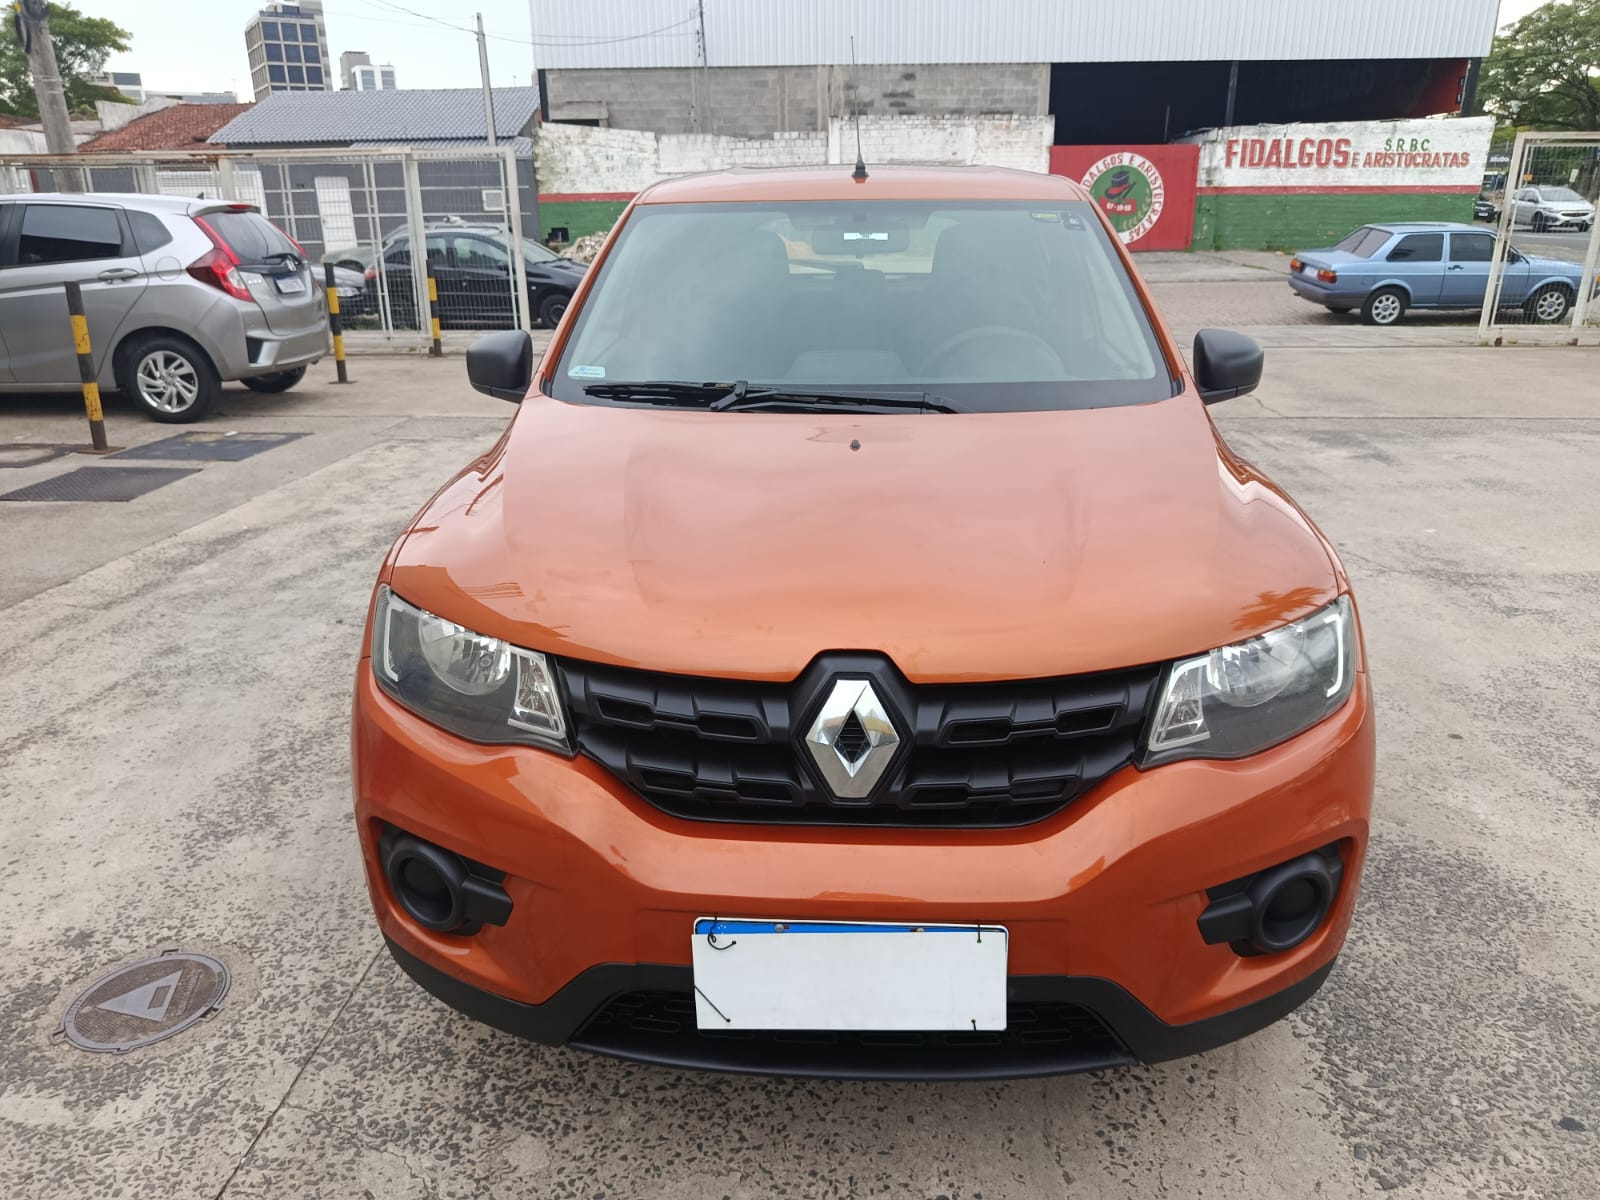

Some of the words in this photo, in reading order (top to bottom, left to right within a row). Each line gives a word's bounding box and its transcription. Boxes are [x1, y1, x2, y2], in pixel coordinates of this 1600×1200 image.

[1225, 138, 1351, 169] FIDALGOS
[1351, 152, 1360, 168] E
[1362, 152, 1470, 168] ARISTOCRATAS
[1082, 154, 1124, 190] DALGOS
[1128, 154, 1136, 166] E
